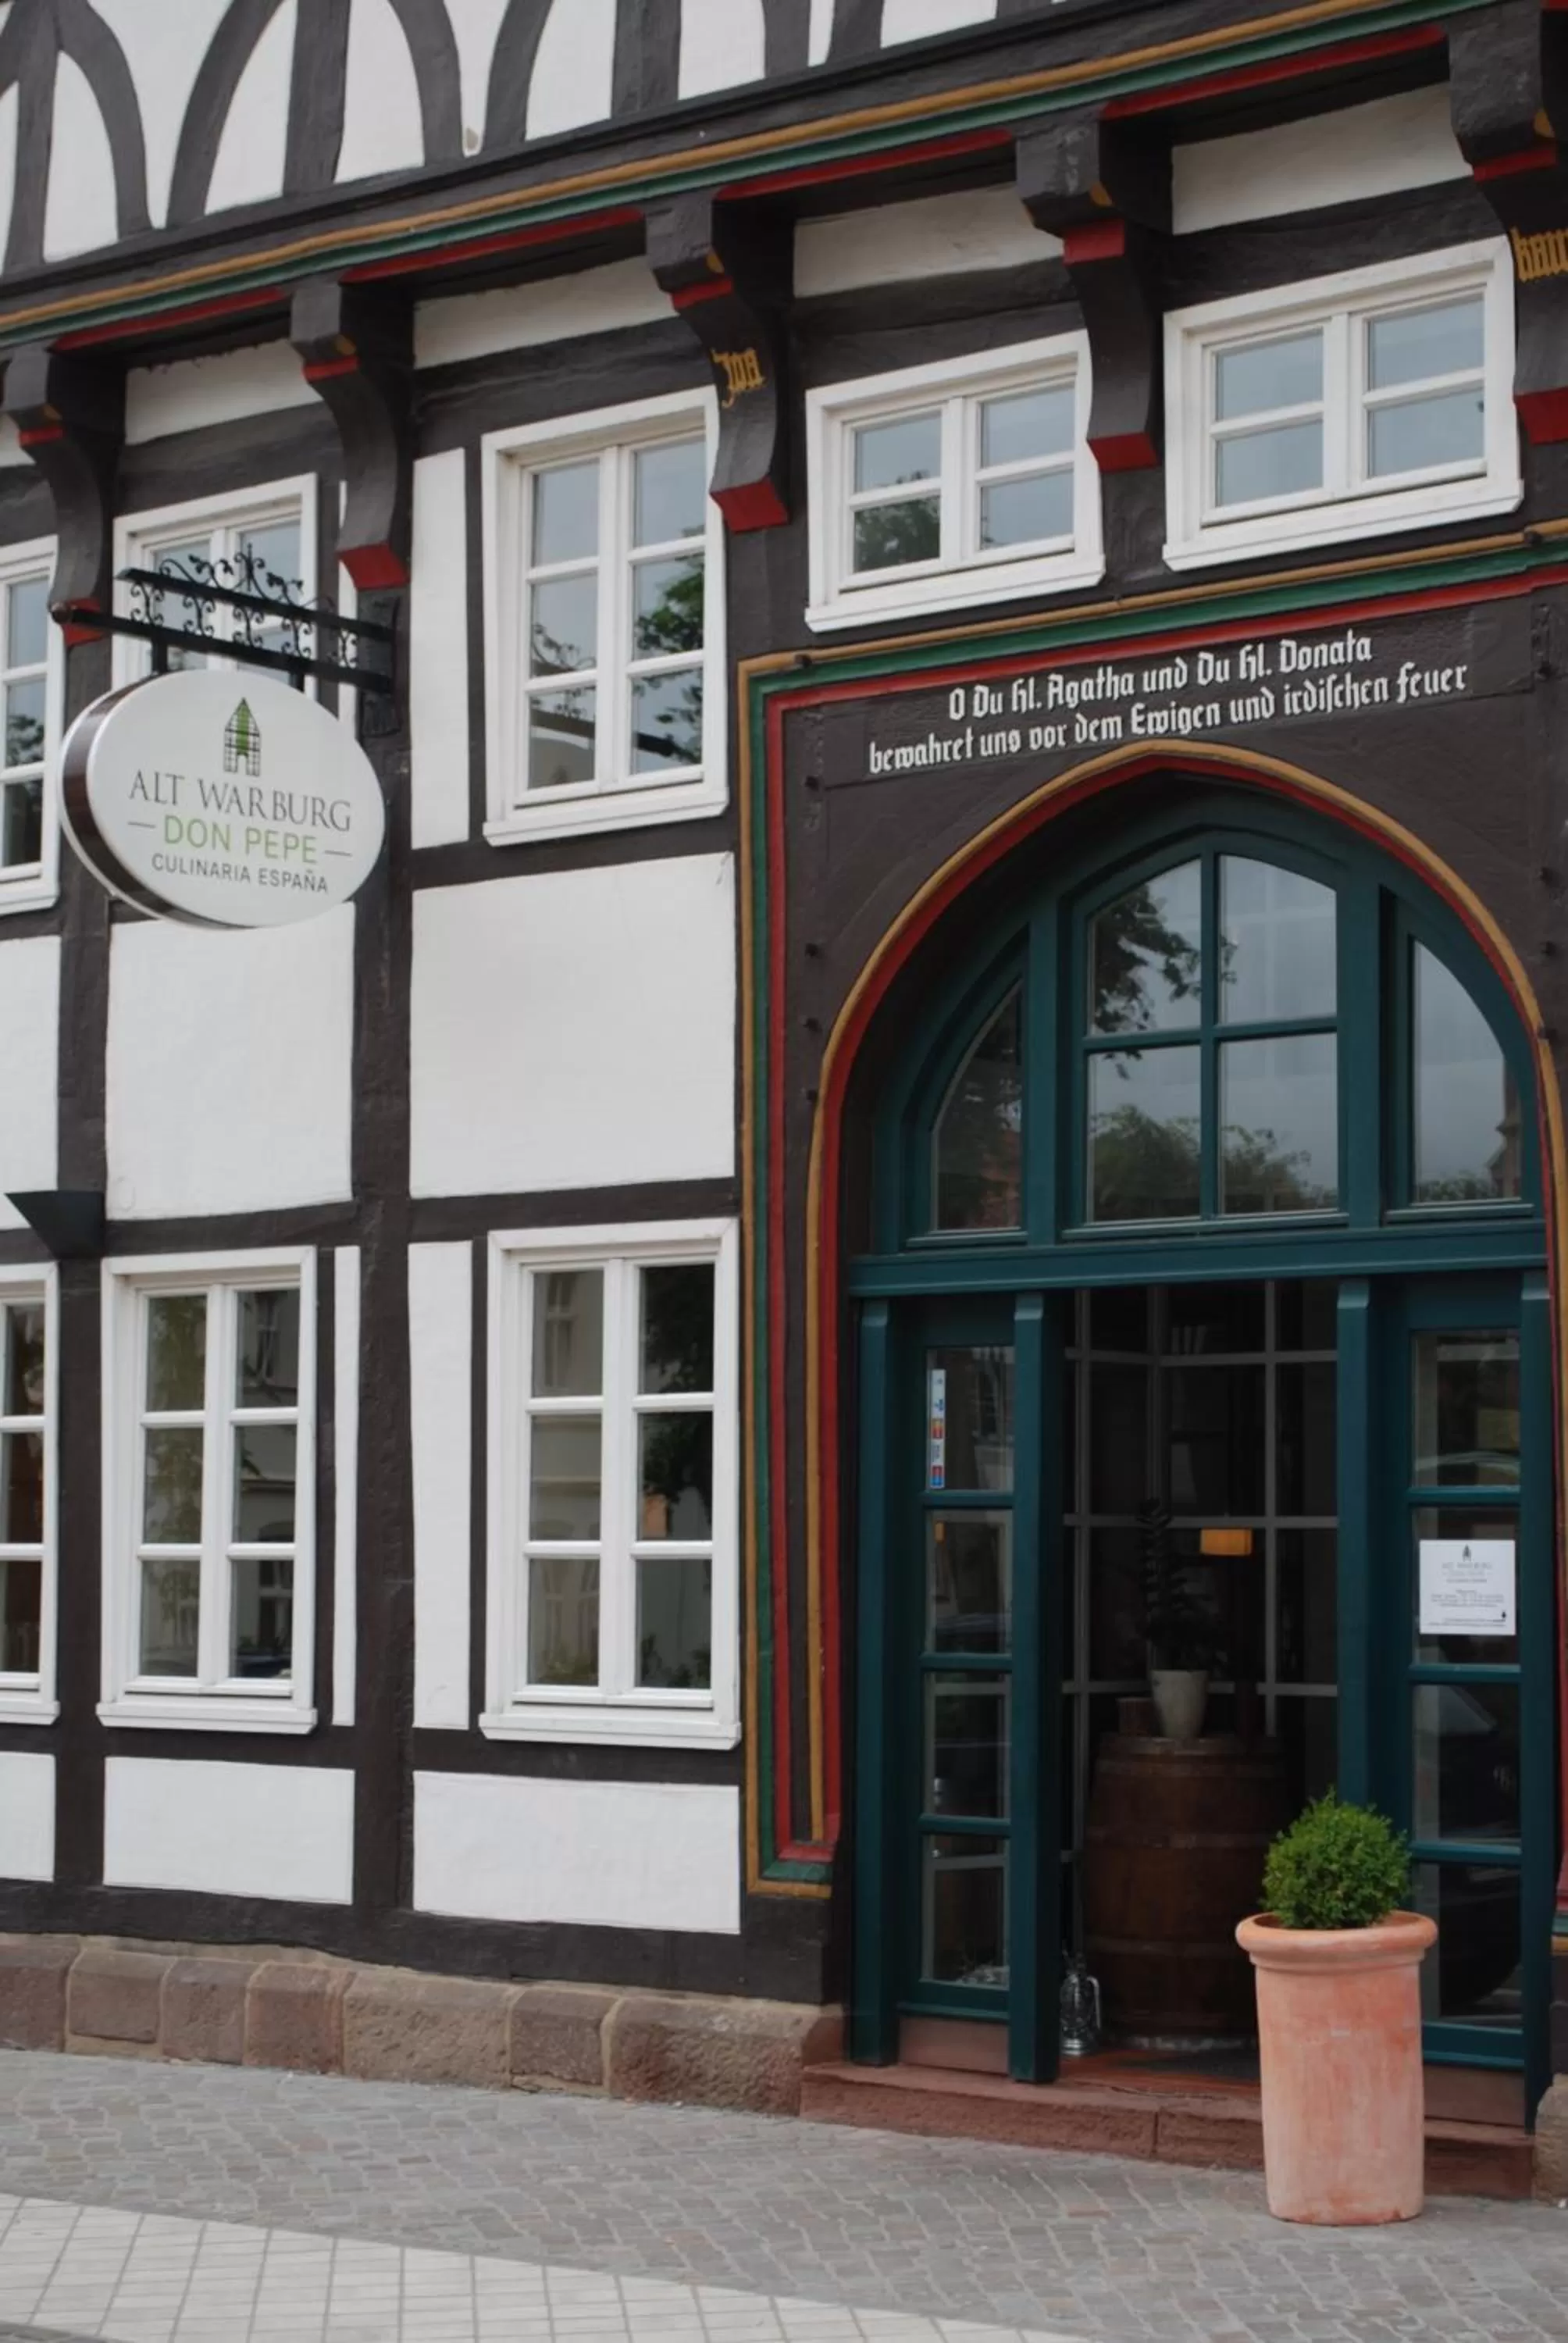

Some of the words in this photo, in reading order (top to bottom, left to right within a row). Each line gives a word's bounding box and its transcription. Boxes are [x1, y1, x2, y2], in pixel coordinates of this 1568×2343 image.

[949, 687, 965, 721] O
[972, 684, 1003, 718] Du
[1046, 665, 1135, 710] Agatha
[1142, 656, 1188, 693] und
[1196, 651, 1231, 686] Du
[1279, 629, 1372, 673] Donata
[869, 726, 974, 774] bewahret
[979, 729, 1021, 757] uns
[1028, 724, 1067, 751] vor
[1074, 712, 1123, 744] dem
[1130, 701, 1221, 735] Ewigen
[1229, 686, 1275, 723] und
[129, 769, 185, 807] ALT
[197, 778, 351, 832] WARBURG
[163, 813, 231, 854] DON
[244, 826, 318, 865] PEPE
[151, 852, 251, 883] CULINARIA
[258, 868, 328, 893] ESPAÑA
